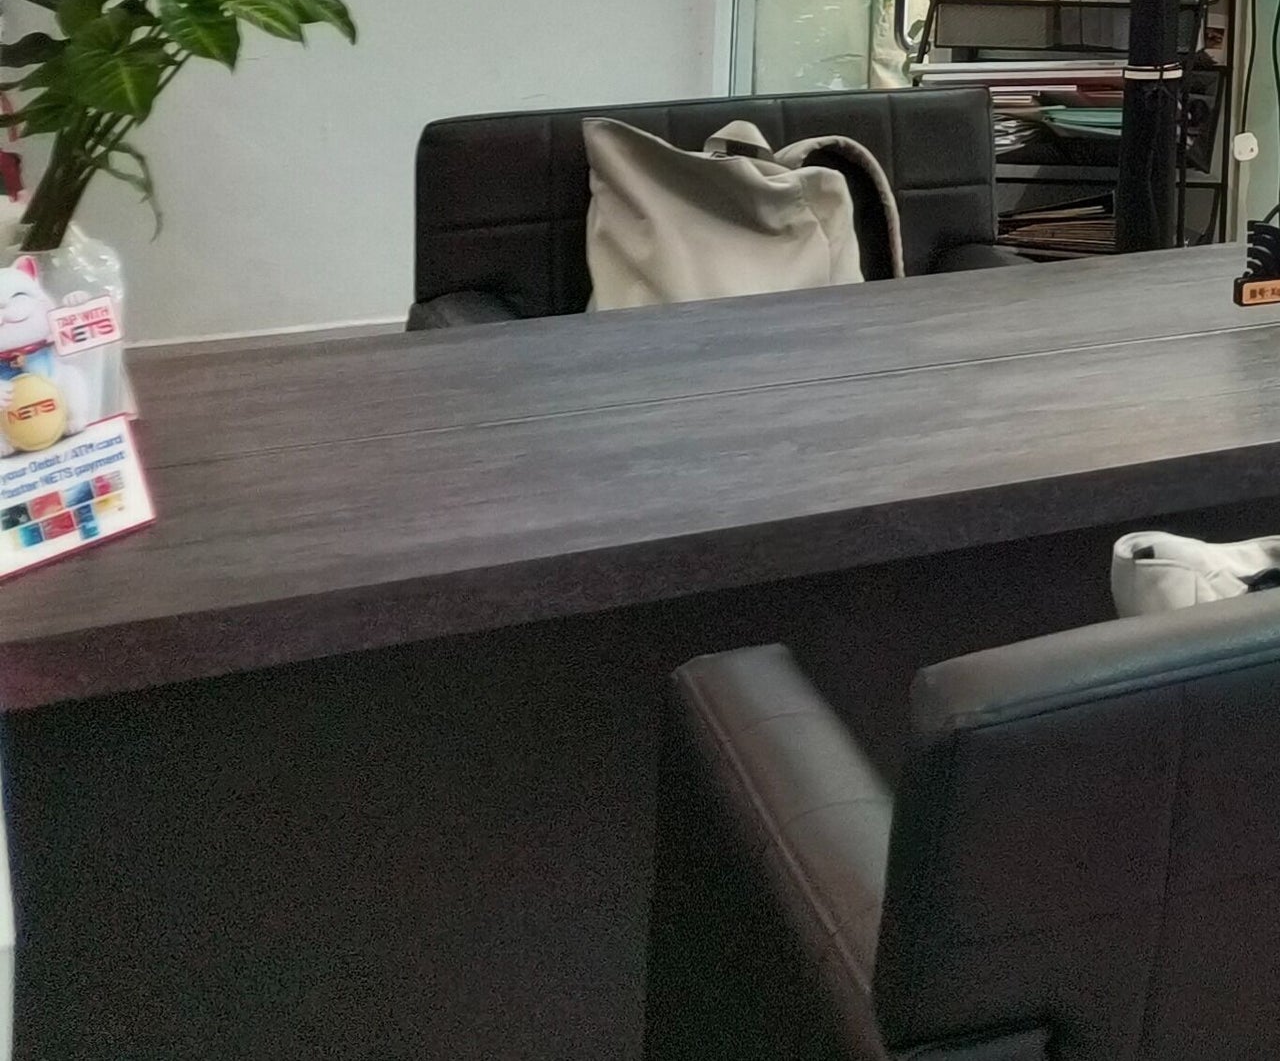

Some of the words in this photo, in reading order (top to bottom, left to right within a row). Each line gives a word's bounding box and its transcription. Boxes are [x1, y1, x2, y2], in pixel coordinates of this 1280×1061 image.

[57, 315, 76, 329] TAP
[80, 305, 110, 322] WITH
[59, 318, 115, 345] NETS
[7, 398, 58, 423] NETS
[70, 442, 96, 462] ATM
[96, 435, 124, 452] card
[40, 466, 73, 486] NETS
[75, 450, 126, 479] payment
